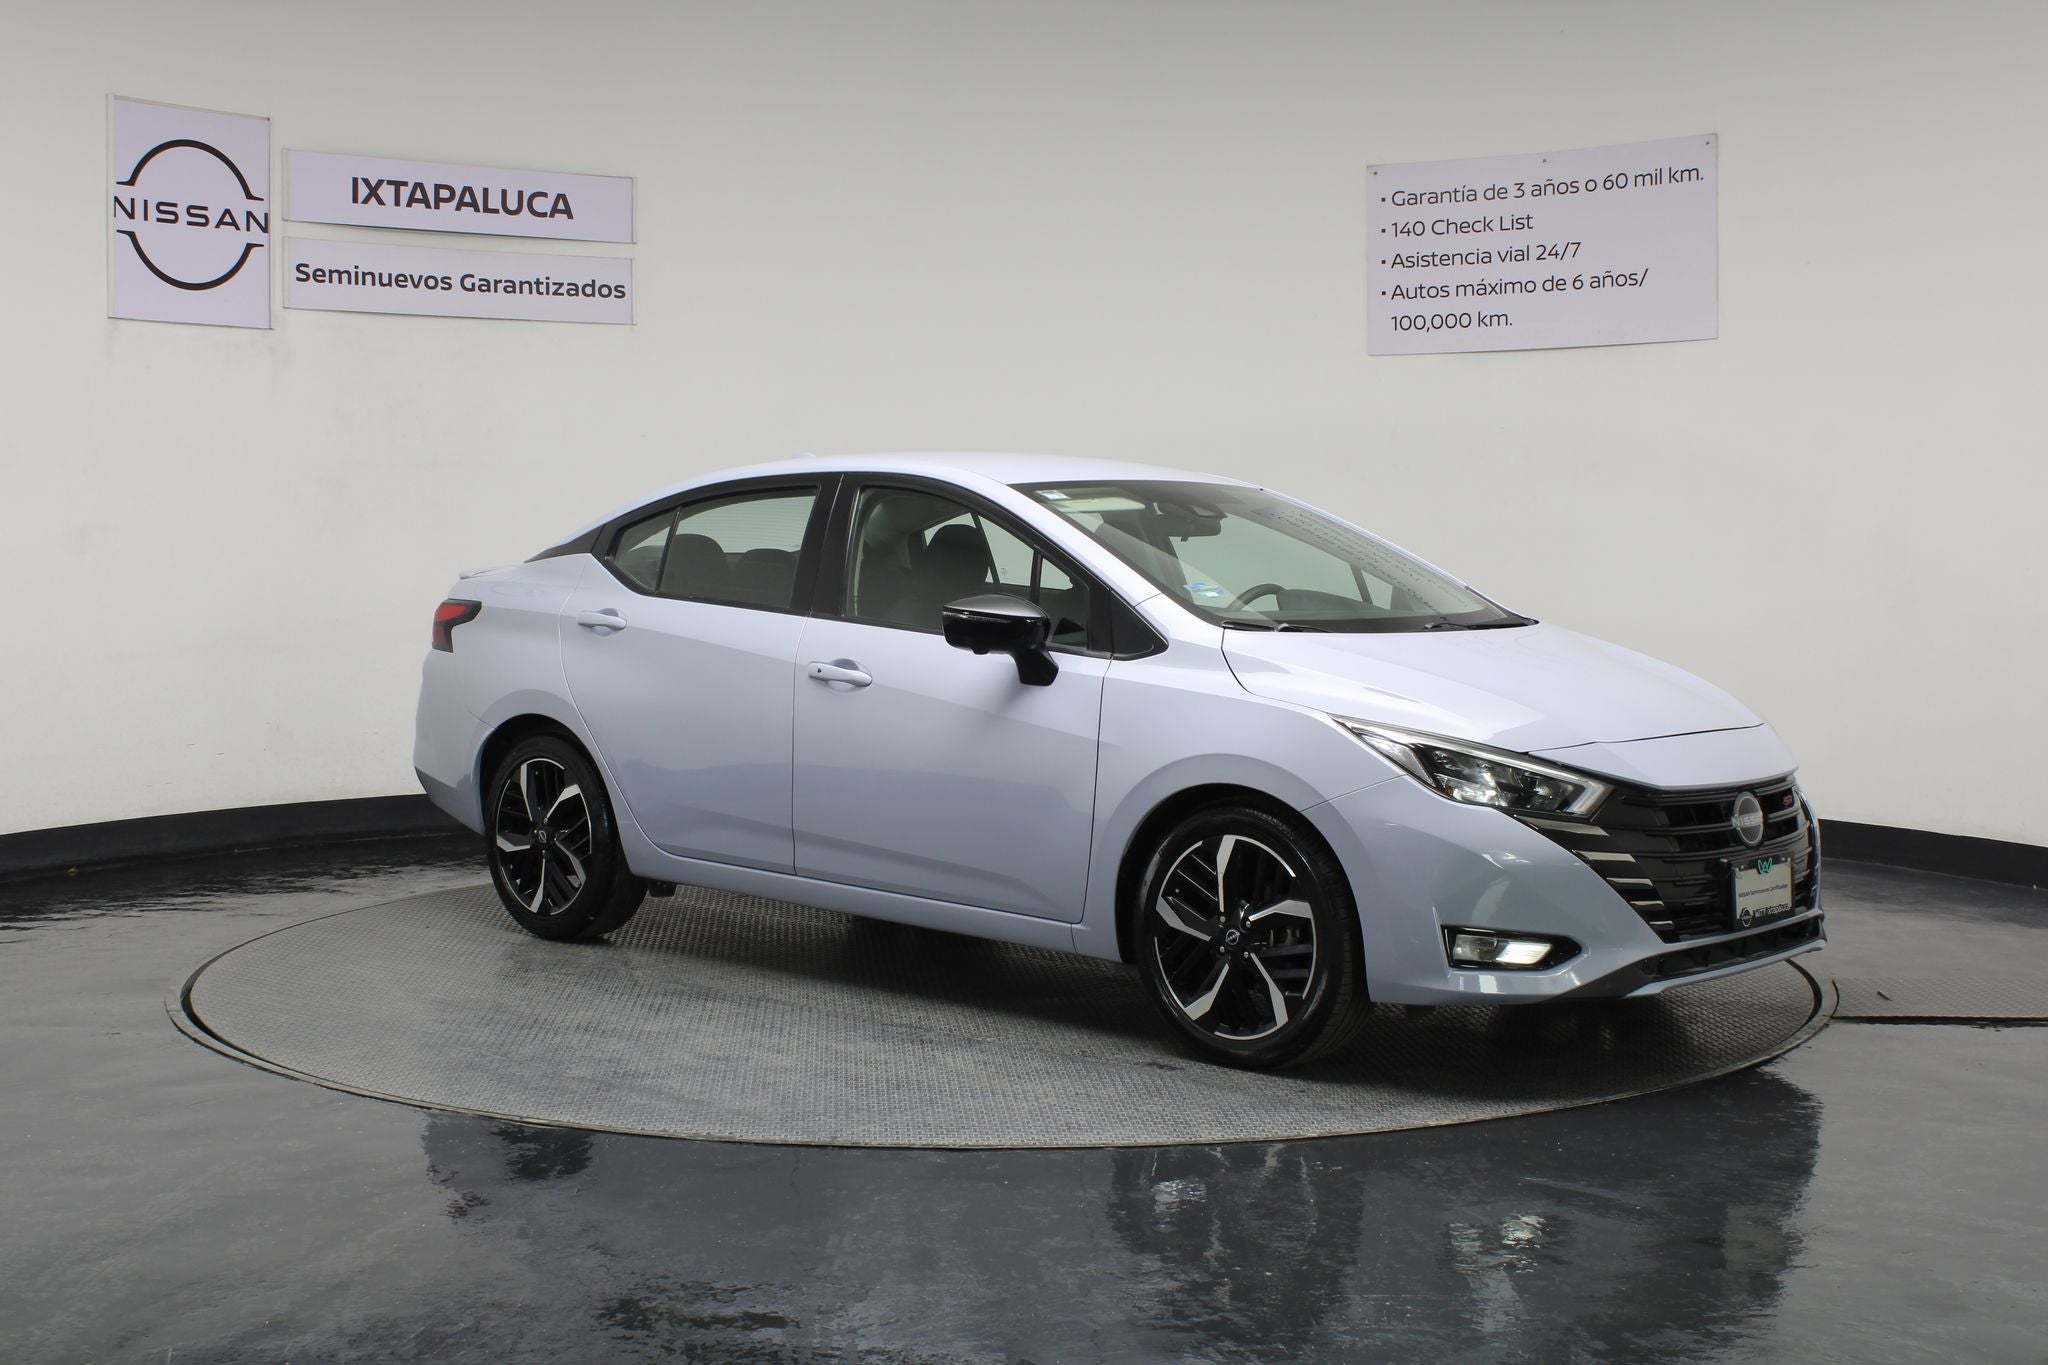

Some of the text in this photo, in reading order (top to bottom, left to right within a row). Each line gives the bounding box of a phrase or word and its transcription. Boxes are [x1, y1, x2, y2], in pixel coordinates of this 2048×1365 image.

[351, 176, 574, 220] IXTAPALUCA
[1391, 166, 1704, 207] Garantía de 3 años o 60 mil km.
[114, 195, 269, 234] NISSAN
[1391, 213, 1534, 238] 140 Check List
[1390, 241, 1582, 269] Asistencia vial 24/7
[295, 262, 627, 299] Seminuevos Garantizados
[1390, 268, 1649, 301] Autos máximo de 6 años/
[1390, 310, 1513, 333] 100,000 km.
[1731, 811, 1761, 828] NISS
